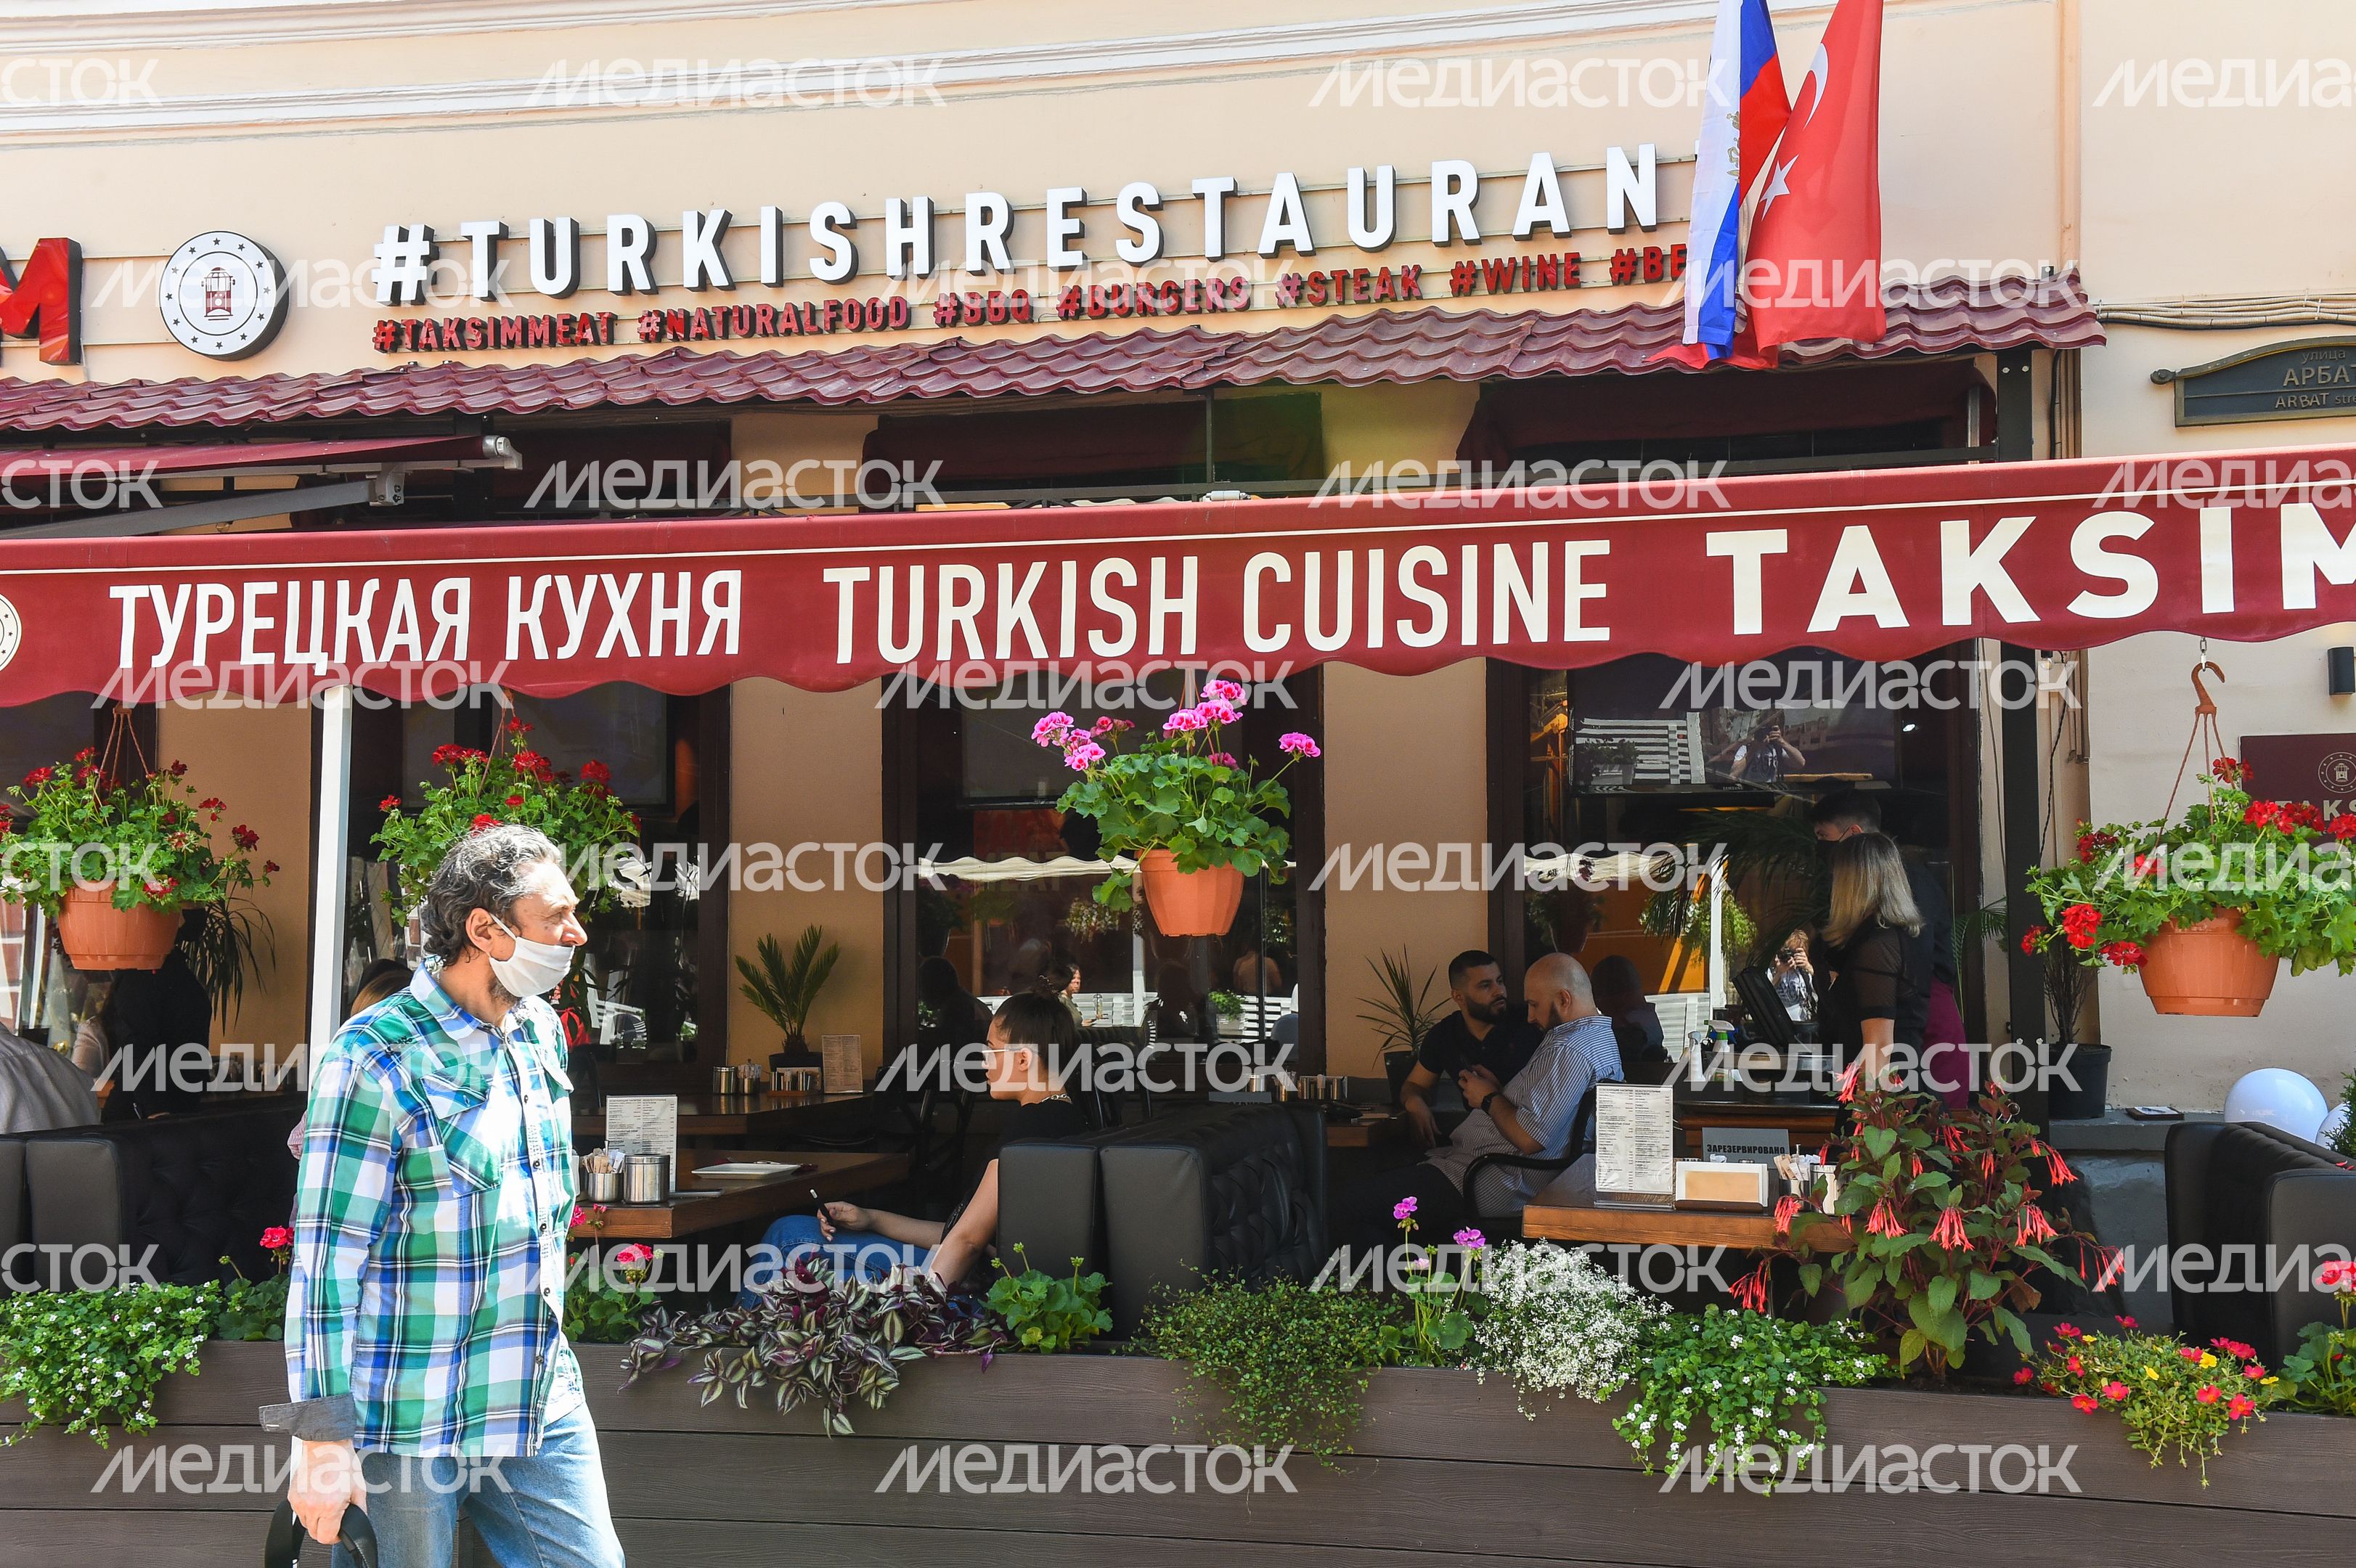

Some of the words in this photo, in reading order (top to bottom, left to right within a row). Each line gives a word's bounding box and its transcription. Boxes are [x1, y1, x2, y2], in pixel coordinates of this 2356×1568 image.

[372, 139, 1699, 306] #TURKISHRESTAURAN
[373, 311, 617, 353] #TAKSIMMEAT
[637, 295, 910, 343] #NATURALFOOD
[934, 288, 1034, 329] #BBQ
[1055, 276, 1252, 320] #BURGERS
[1276, 264, 1423, 306] #STEAK
[1450, 252, 1582, 297] #WINE
[2275, 393, 2330, 409] ARBAT
[2302, 349, 2346, 364] улица
[823, 556, 1199, 665] TURKISH
[1243, 539, 1610, 654] CUISINE
[1705, 502, 2356, 635] TAKSIM
[109, 577, 471, 676] ТУРЕЦКАЯ
[505, 570, 742, 661] КУХНЯ
[1707, 1144, 1785, 1154] ЗАРЕЗЕРВИРОВАНО
